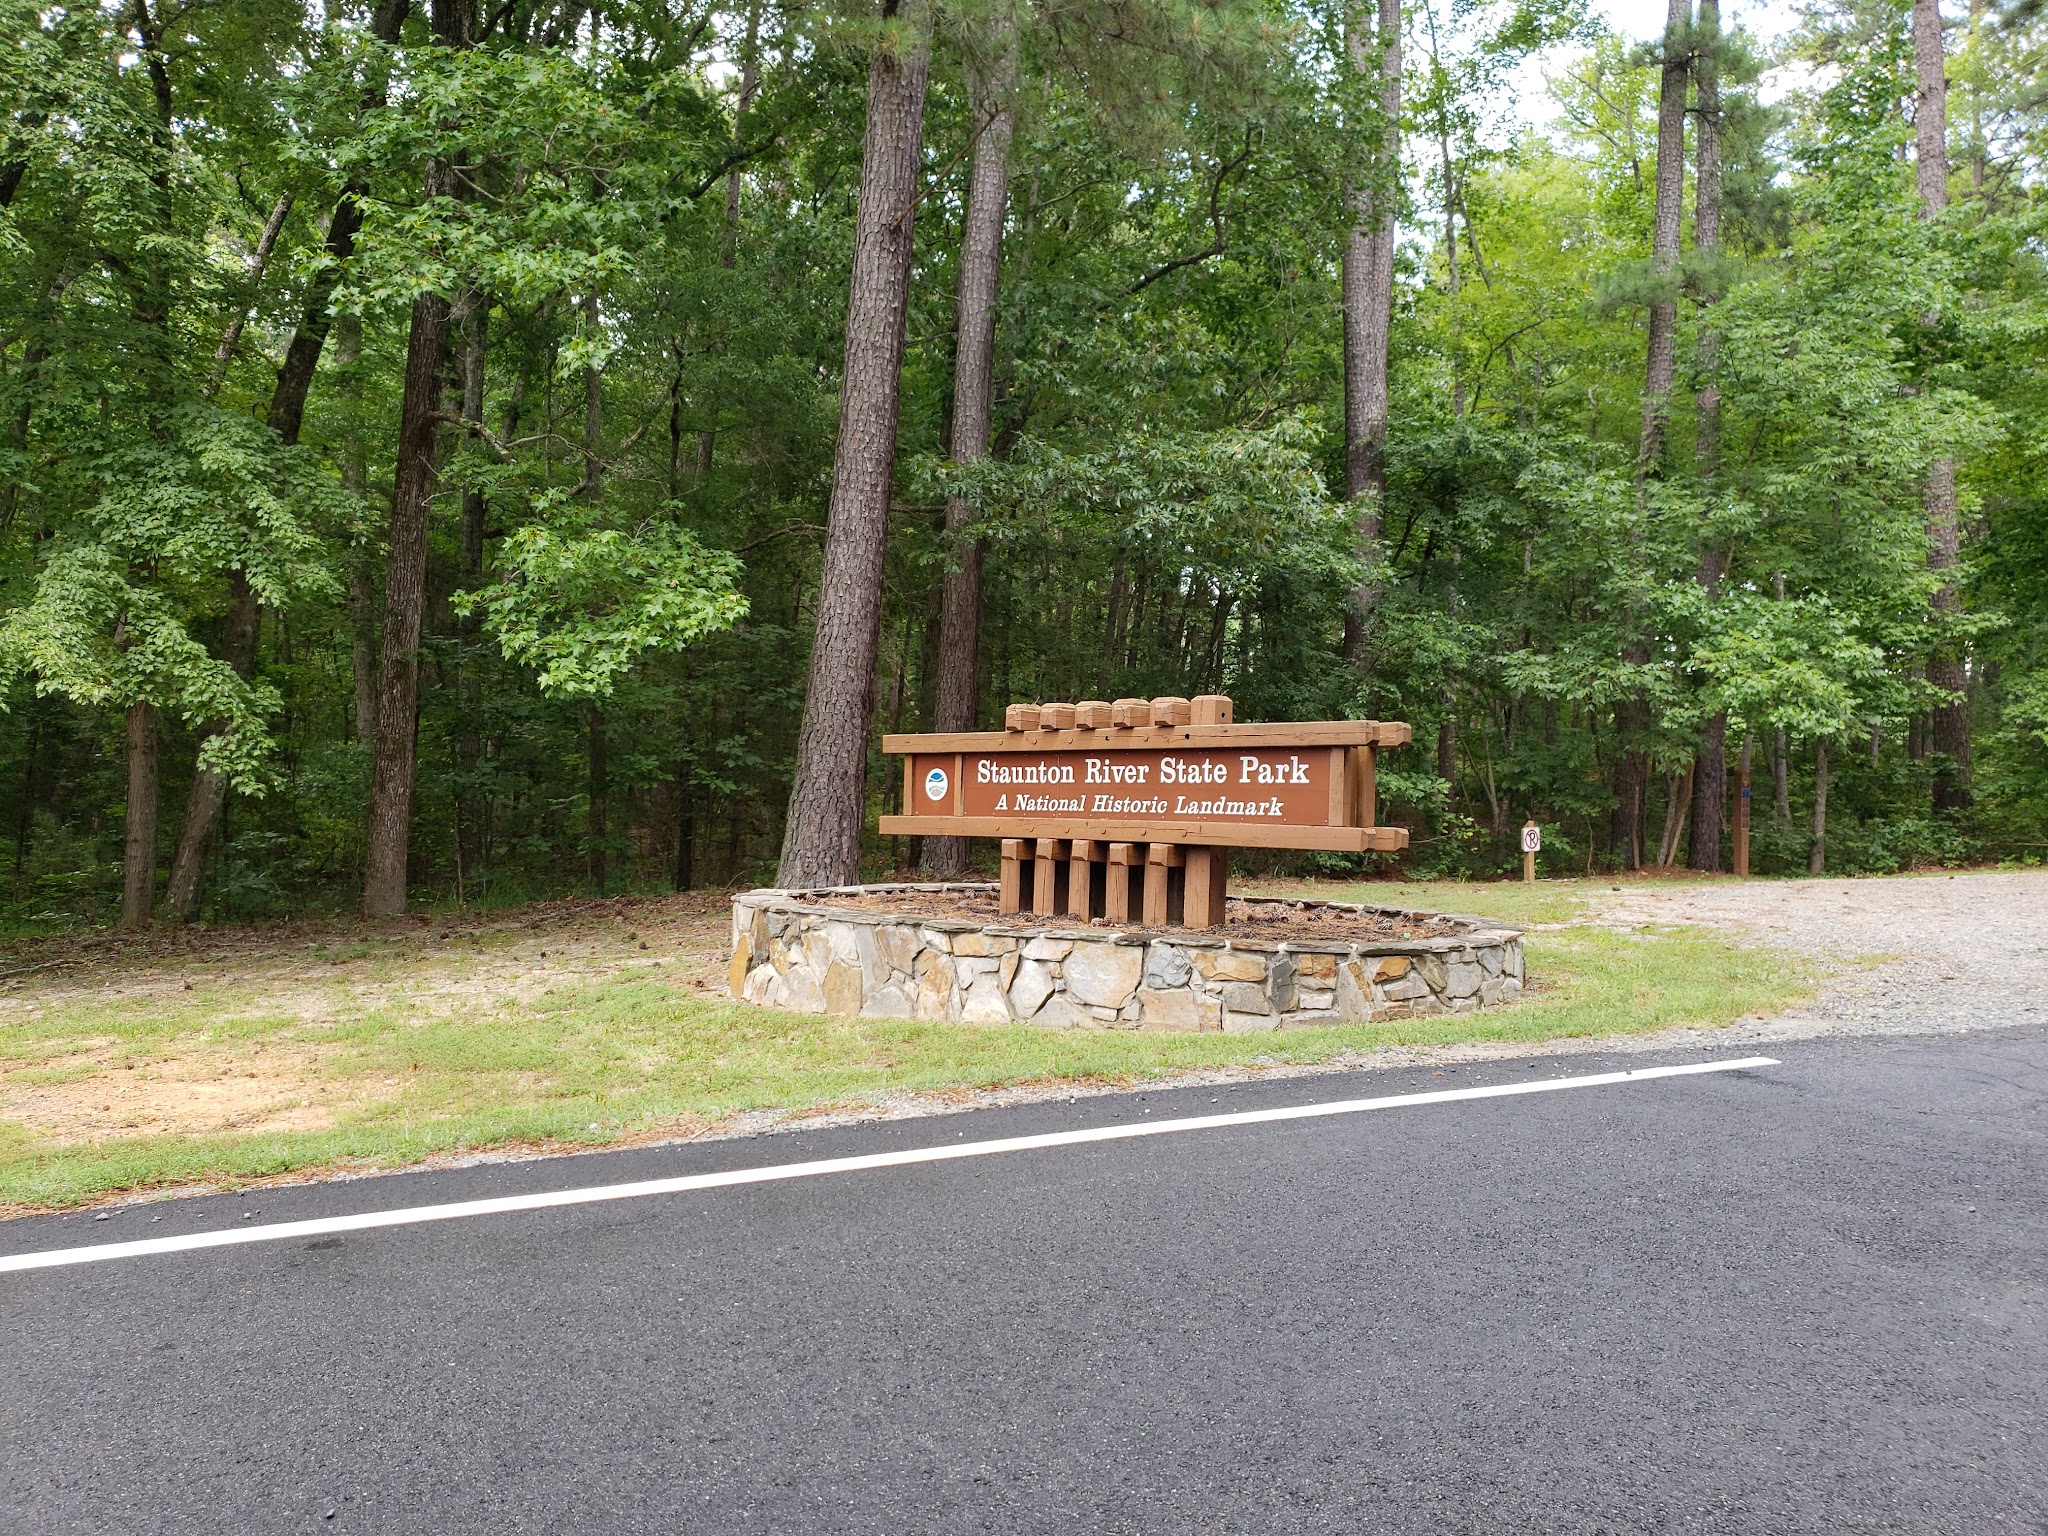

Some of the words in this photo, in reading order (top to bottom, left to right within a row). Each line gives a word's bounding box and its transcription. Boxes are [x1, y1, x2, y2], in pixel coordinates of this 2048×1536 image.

[977, 759, 1075, 785] Staunton
[1084, 758, 1149, 785] River
[1160, 757, 1227, 784] State
[1239, 756, 1310, 785] Park
[994, 794, 1008, 811] A
[1014, 794, 1085, 813] National
[1091, 794, 1168, 815] Historic
[1174, 796, 1284, 817] Landmark
